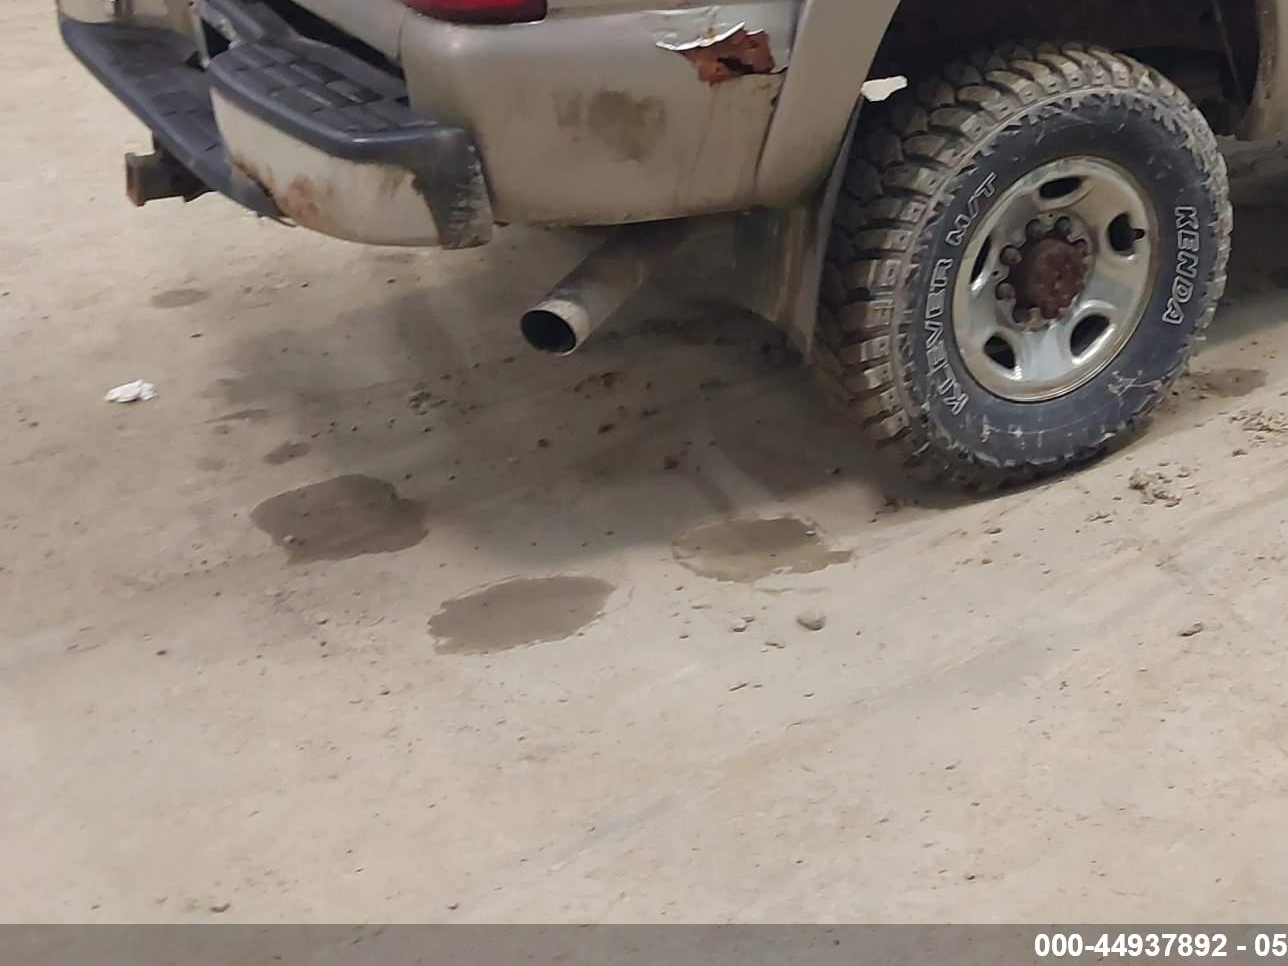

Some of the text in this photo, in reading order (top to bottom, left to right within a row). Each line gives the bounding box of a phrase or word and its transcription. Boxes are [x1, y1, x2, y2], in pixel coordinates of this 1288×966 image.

[924, 172, 998, 416] KLEVER M/T
[1162, 205, 1200, 325] KENDA
